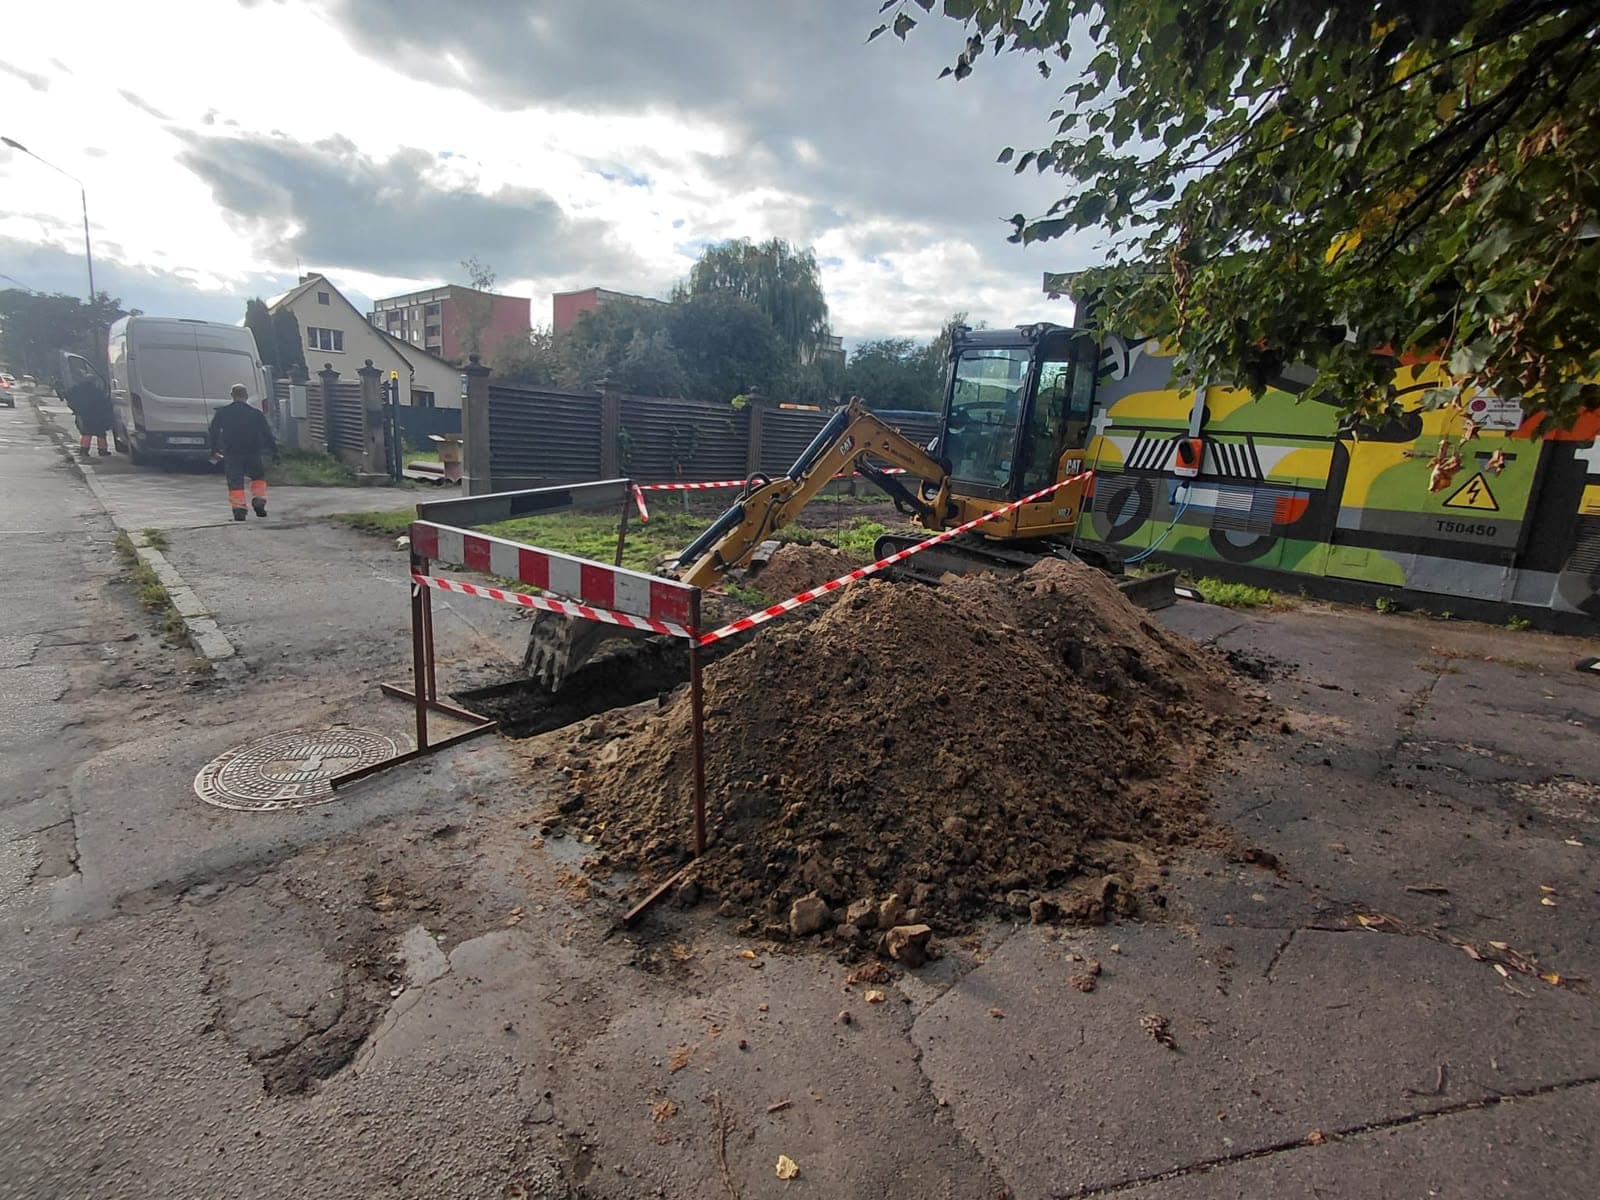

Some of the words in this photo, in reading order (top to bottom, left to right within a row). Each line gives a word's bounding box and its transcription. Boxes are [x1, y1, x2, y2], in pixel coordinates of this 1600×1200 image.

[840, 437, 853, 456] CAT
[1066, 459, 1081, 475] CAT
[1436, 520, 1497, 537] T50450
